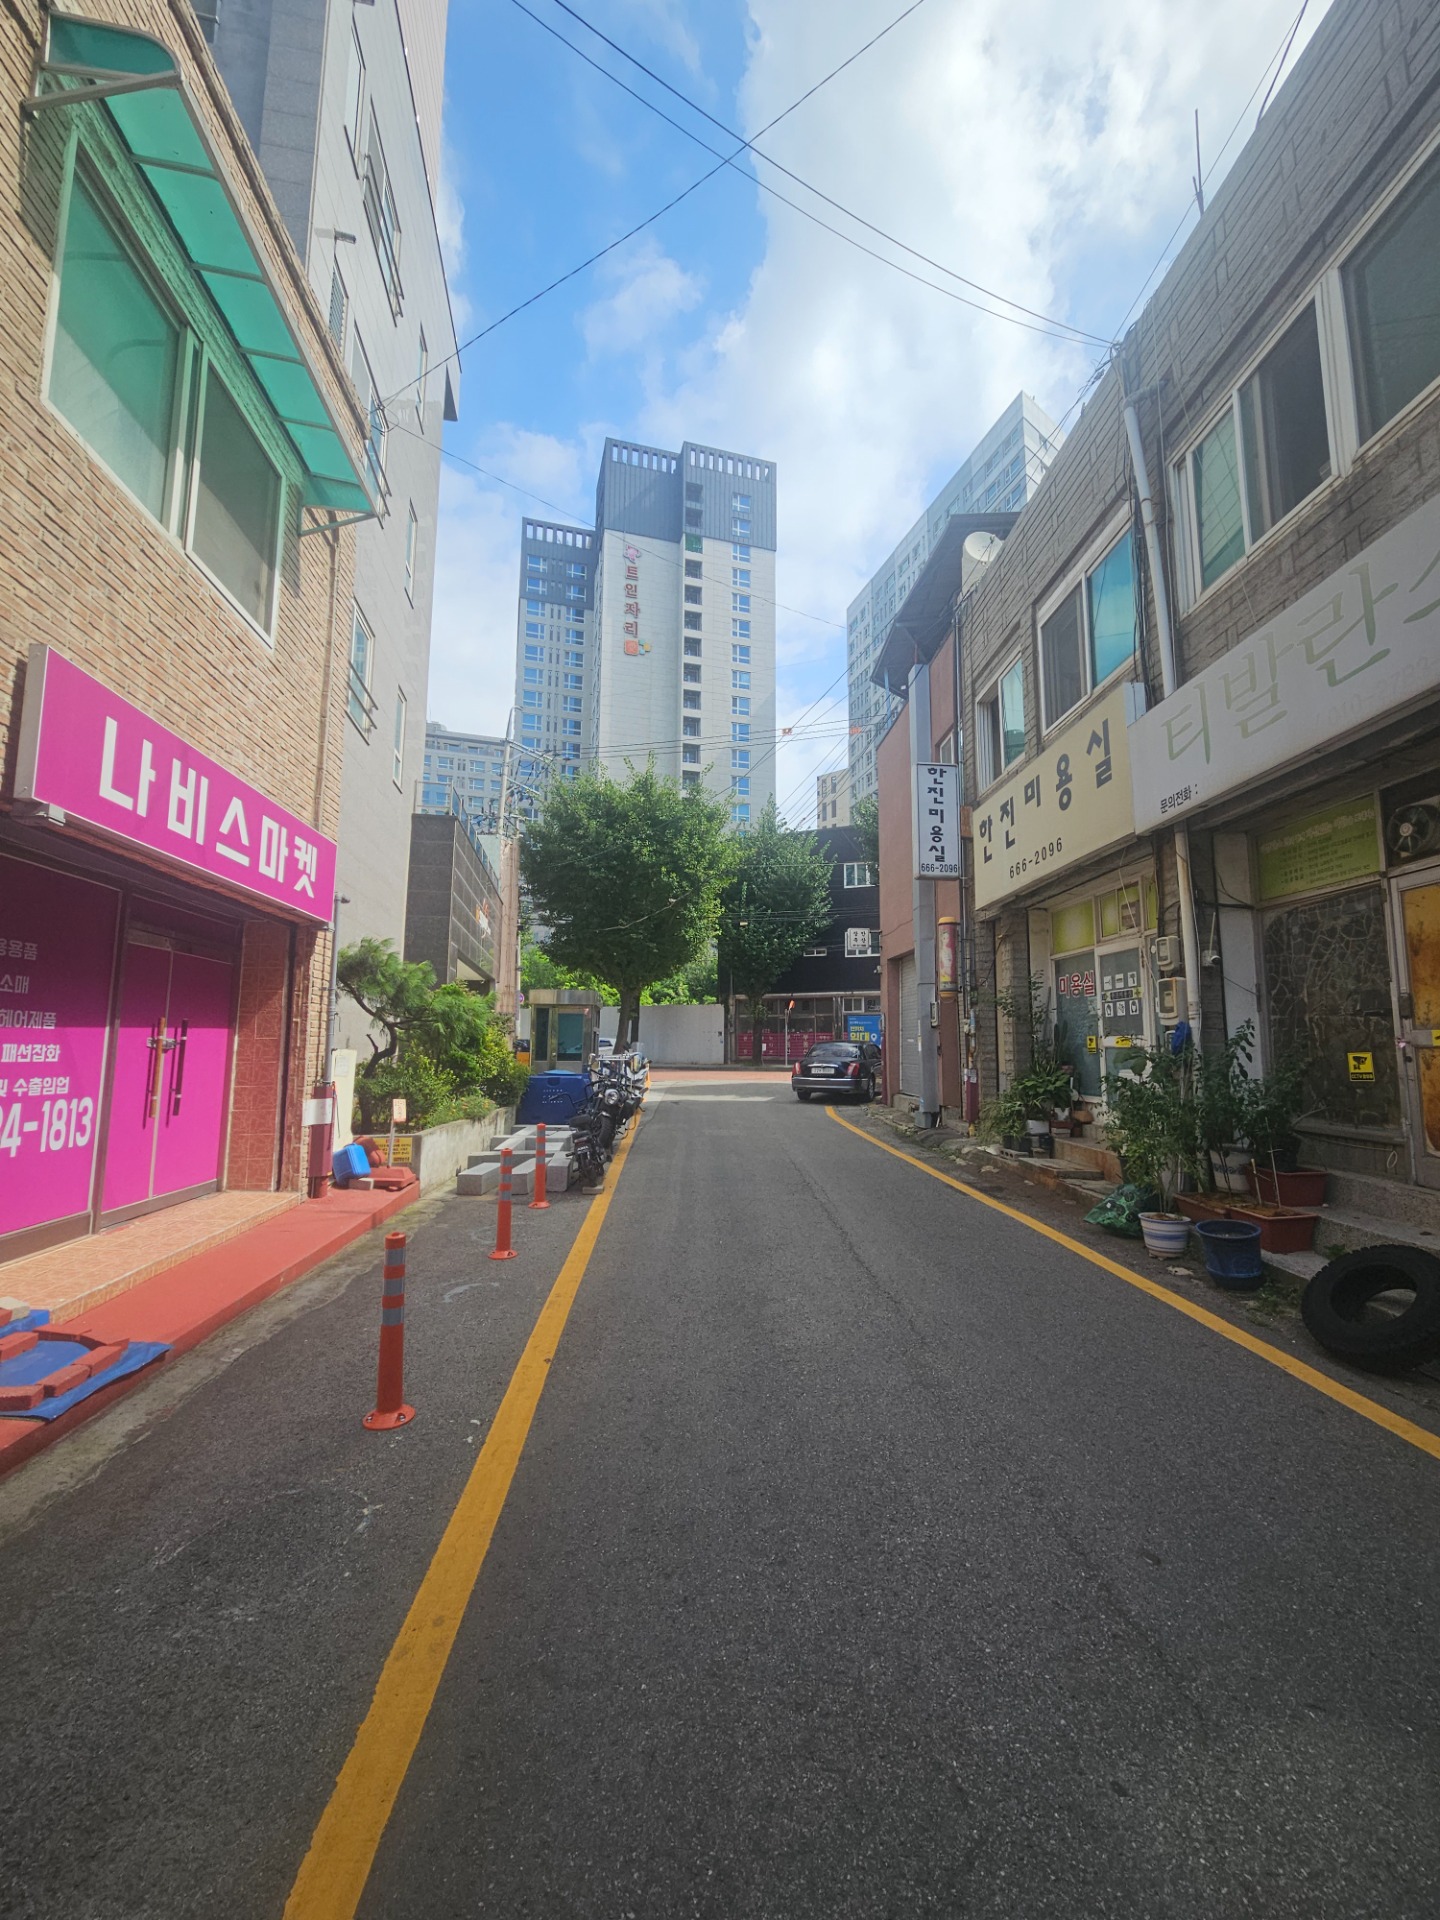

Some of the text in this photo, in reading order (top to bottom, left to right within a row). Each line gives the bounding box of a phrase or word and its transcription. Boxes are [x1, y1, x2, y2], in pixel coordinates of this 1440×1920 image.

[99, 715, 317, 899] 나비스마켓
[979, 718, 1113, 864] 한진미용실
[927, 767, 947, 863] 한진미용실
[921, 863, 958, 874] 666-2096
[1009, 836, 1063, 879] 666-2096
[1059, 969, 1096, 999] 미용실
[0, 1009, 57, 1029] 헤어제품
[1, 1044, 60, 1063] 패션잡화
[0, 1096, 94, 1158] 4-1813
